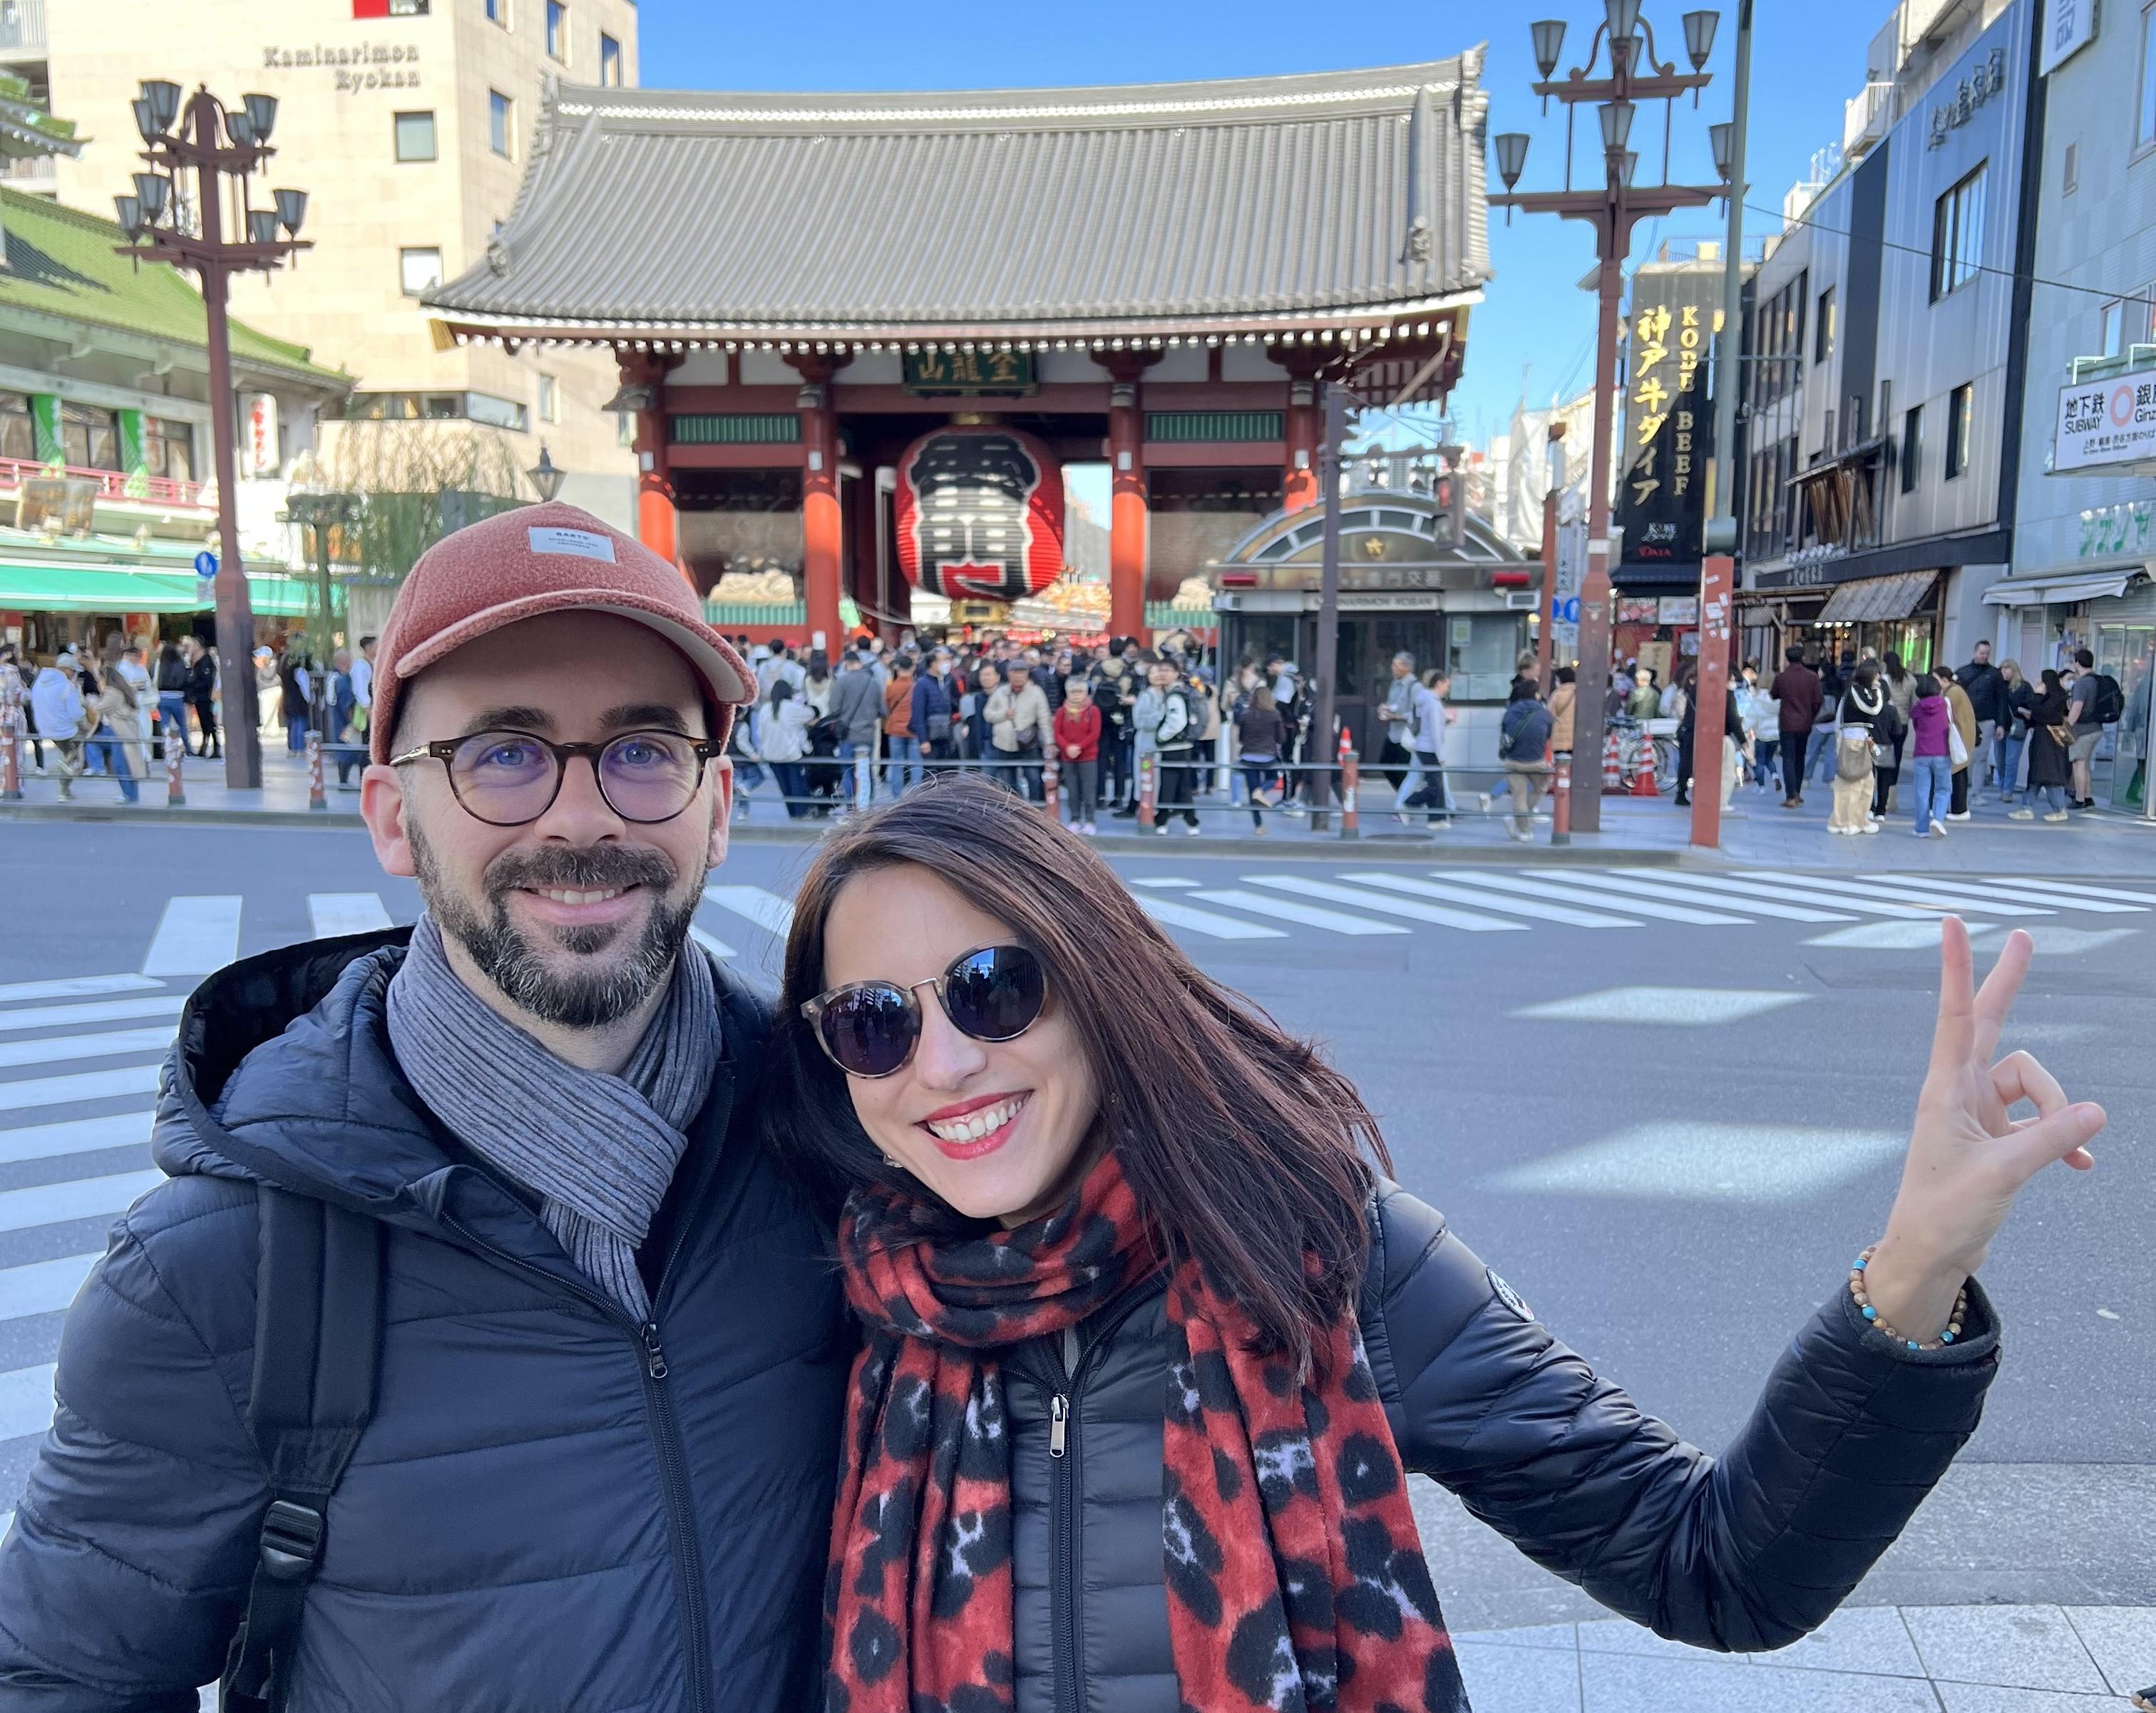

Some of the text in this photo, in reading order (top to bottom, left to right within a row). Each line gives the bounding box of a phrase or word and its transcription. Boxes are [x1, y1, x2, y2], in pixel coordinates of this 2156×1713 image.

[263, 41, 419, 68] Kaminarimon
[334, 68, 421, 96] Ryokan
[1633, 304, 1672, 506] 神戸牛ダイア
[1673, 305, 1700, 495] KOBE BEEF
[2065, 384, 2156, 419] 地下鉄 銀
[2065, 415, 2104, 434] SUBWAY
